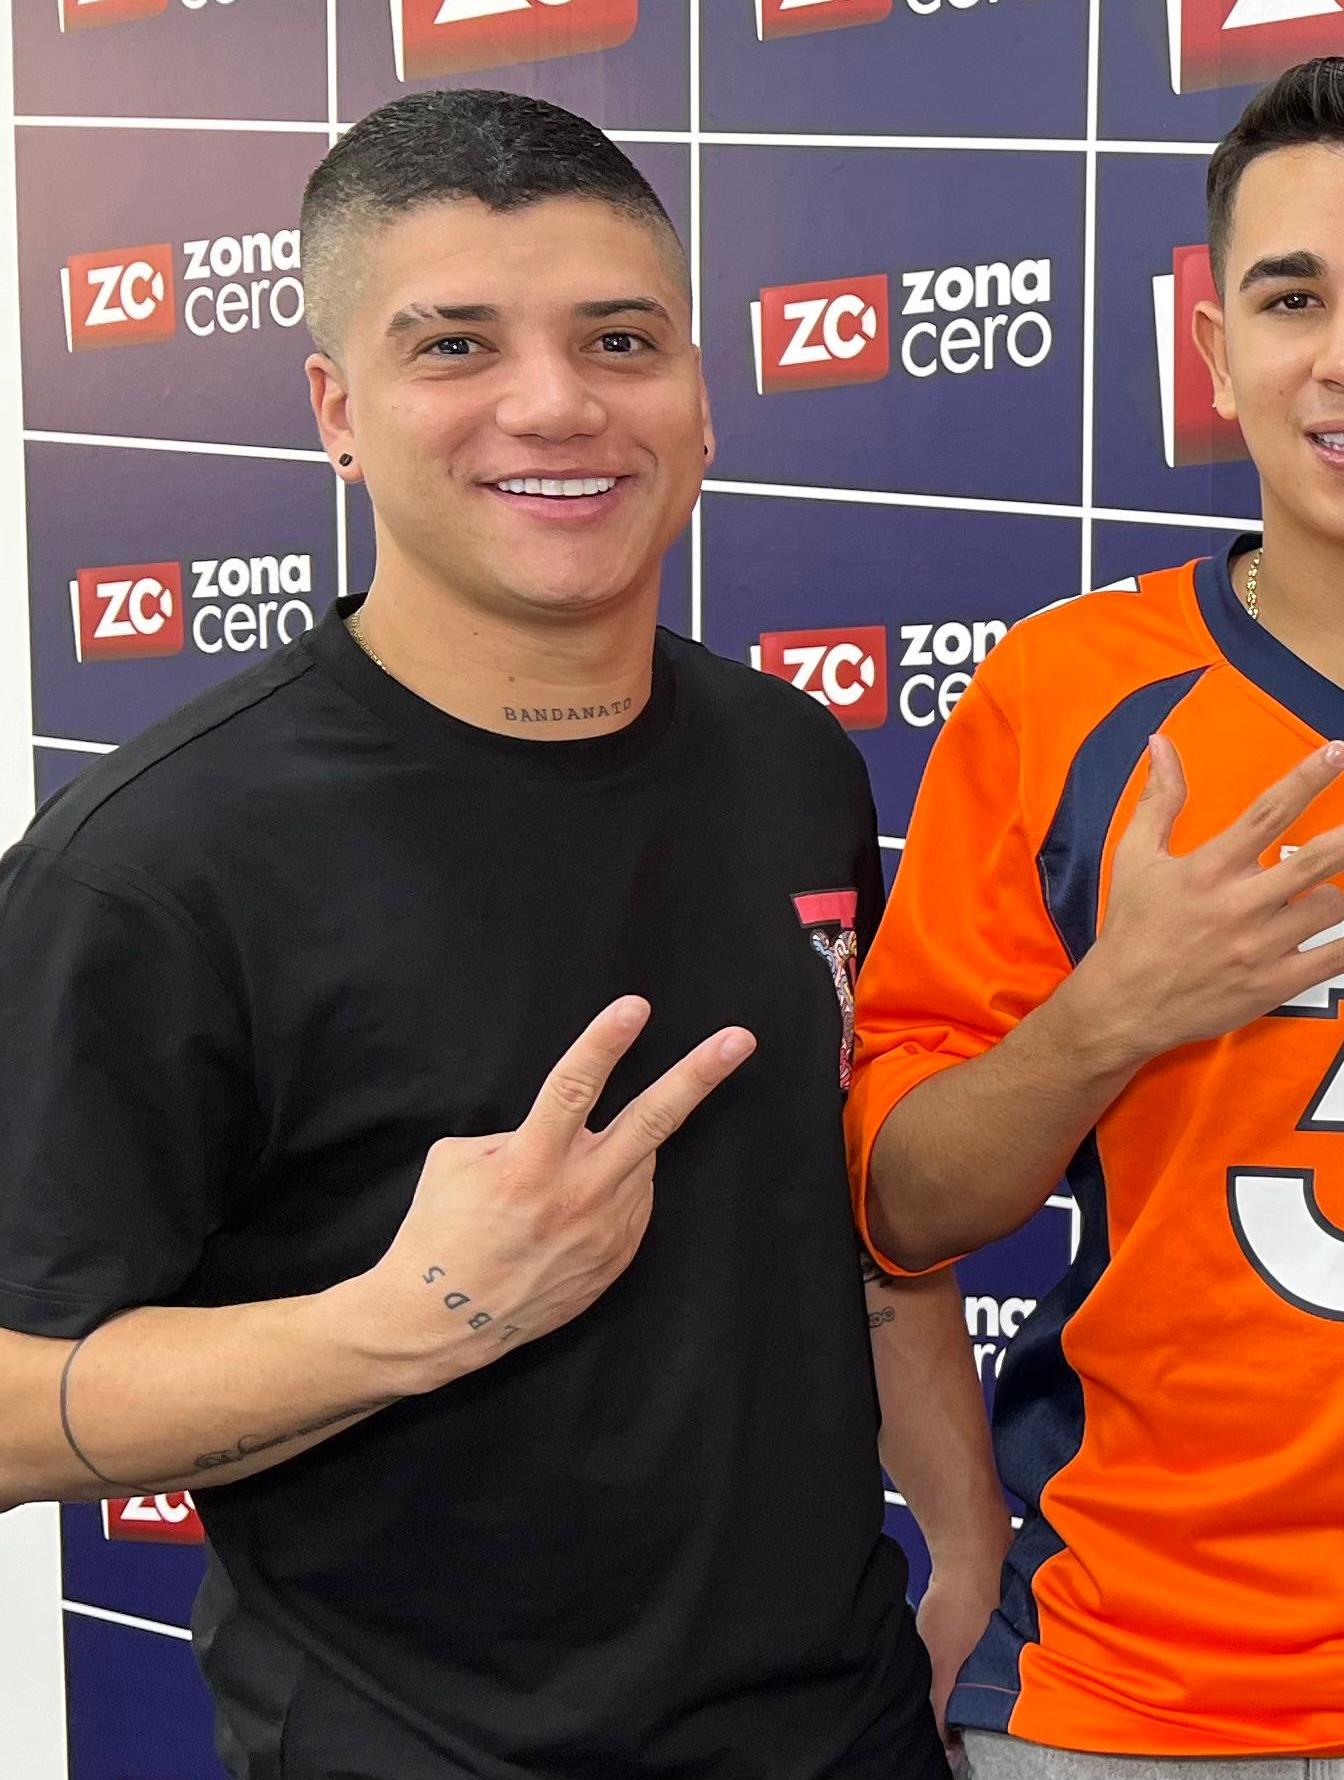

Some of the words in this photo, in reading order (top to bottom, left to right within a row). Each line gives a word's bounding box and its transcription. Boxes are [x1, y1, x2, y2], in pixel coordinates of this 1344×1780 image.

[183, 229, 301, 280] zona
[184, 276, 306, 337] cero
[902, 258, 1051, 315] zona
[901, 310, 1052, 378] cero
[191, 554, 312, 598] zona
[193, 600, 314, 654] cero
[900, 620, 1008, 667] zon
[503, 697, 632, 722] BANDANATO
[899, 672, 974, 727] ce
[965, 1296, 1037, 1338] na
